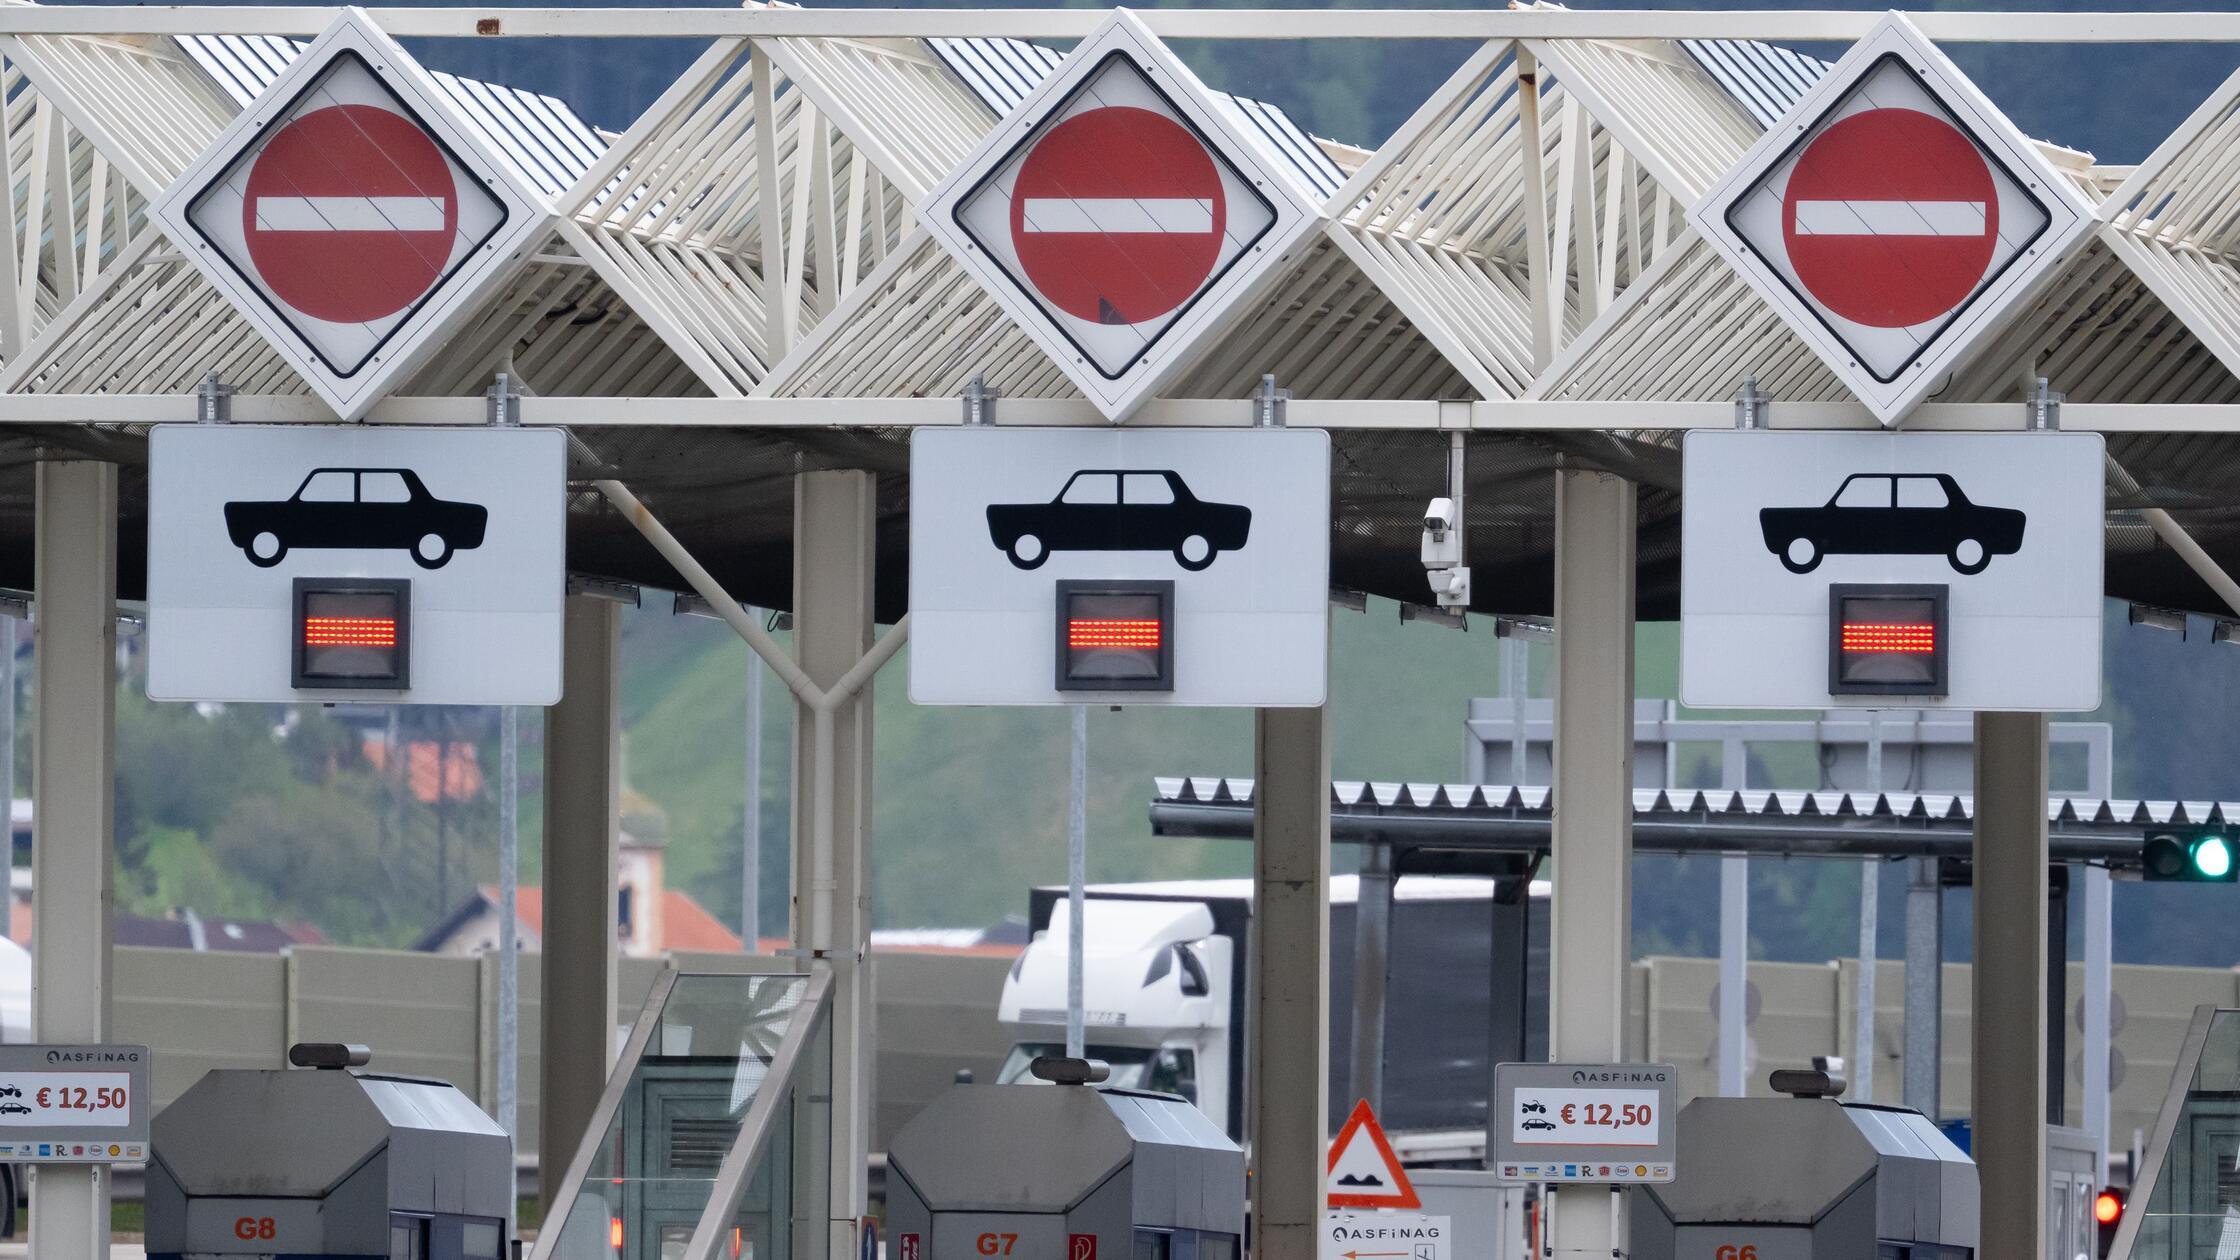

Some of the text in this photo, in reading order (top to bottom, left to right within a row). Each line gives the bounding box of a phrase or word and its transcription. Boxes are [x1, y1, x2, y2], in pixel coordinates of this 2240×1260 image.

[36, 1087, 126, 1113] € 12,50
[1561, 1103, 1652, 1129] € 12,50
[234, 1216, 276, 1240] G8
[976, 1232, 1018, 1256] G7
[1715, 1244, 1757, 1260] G6
